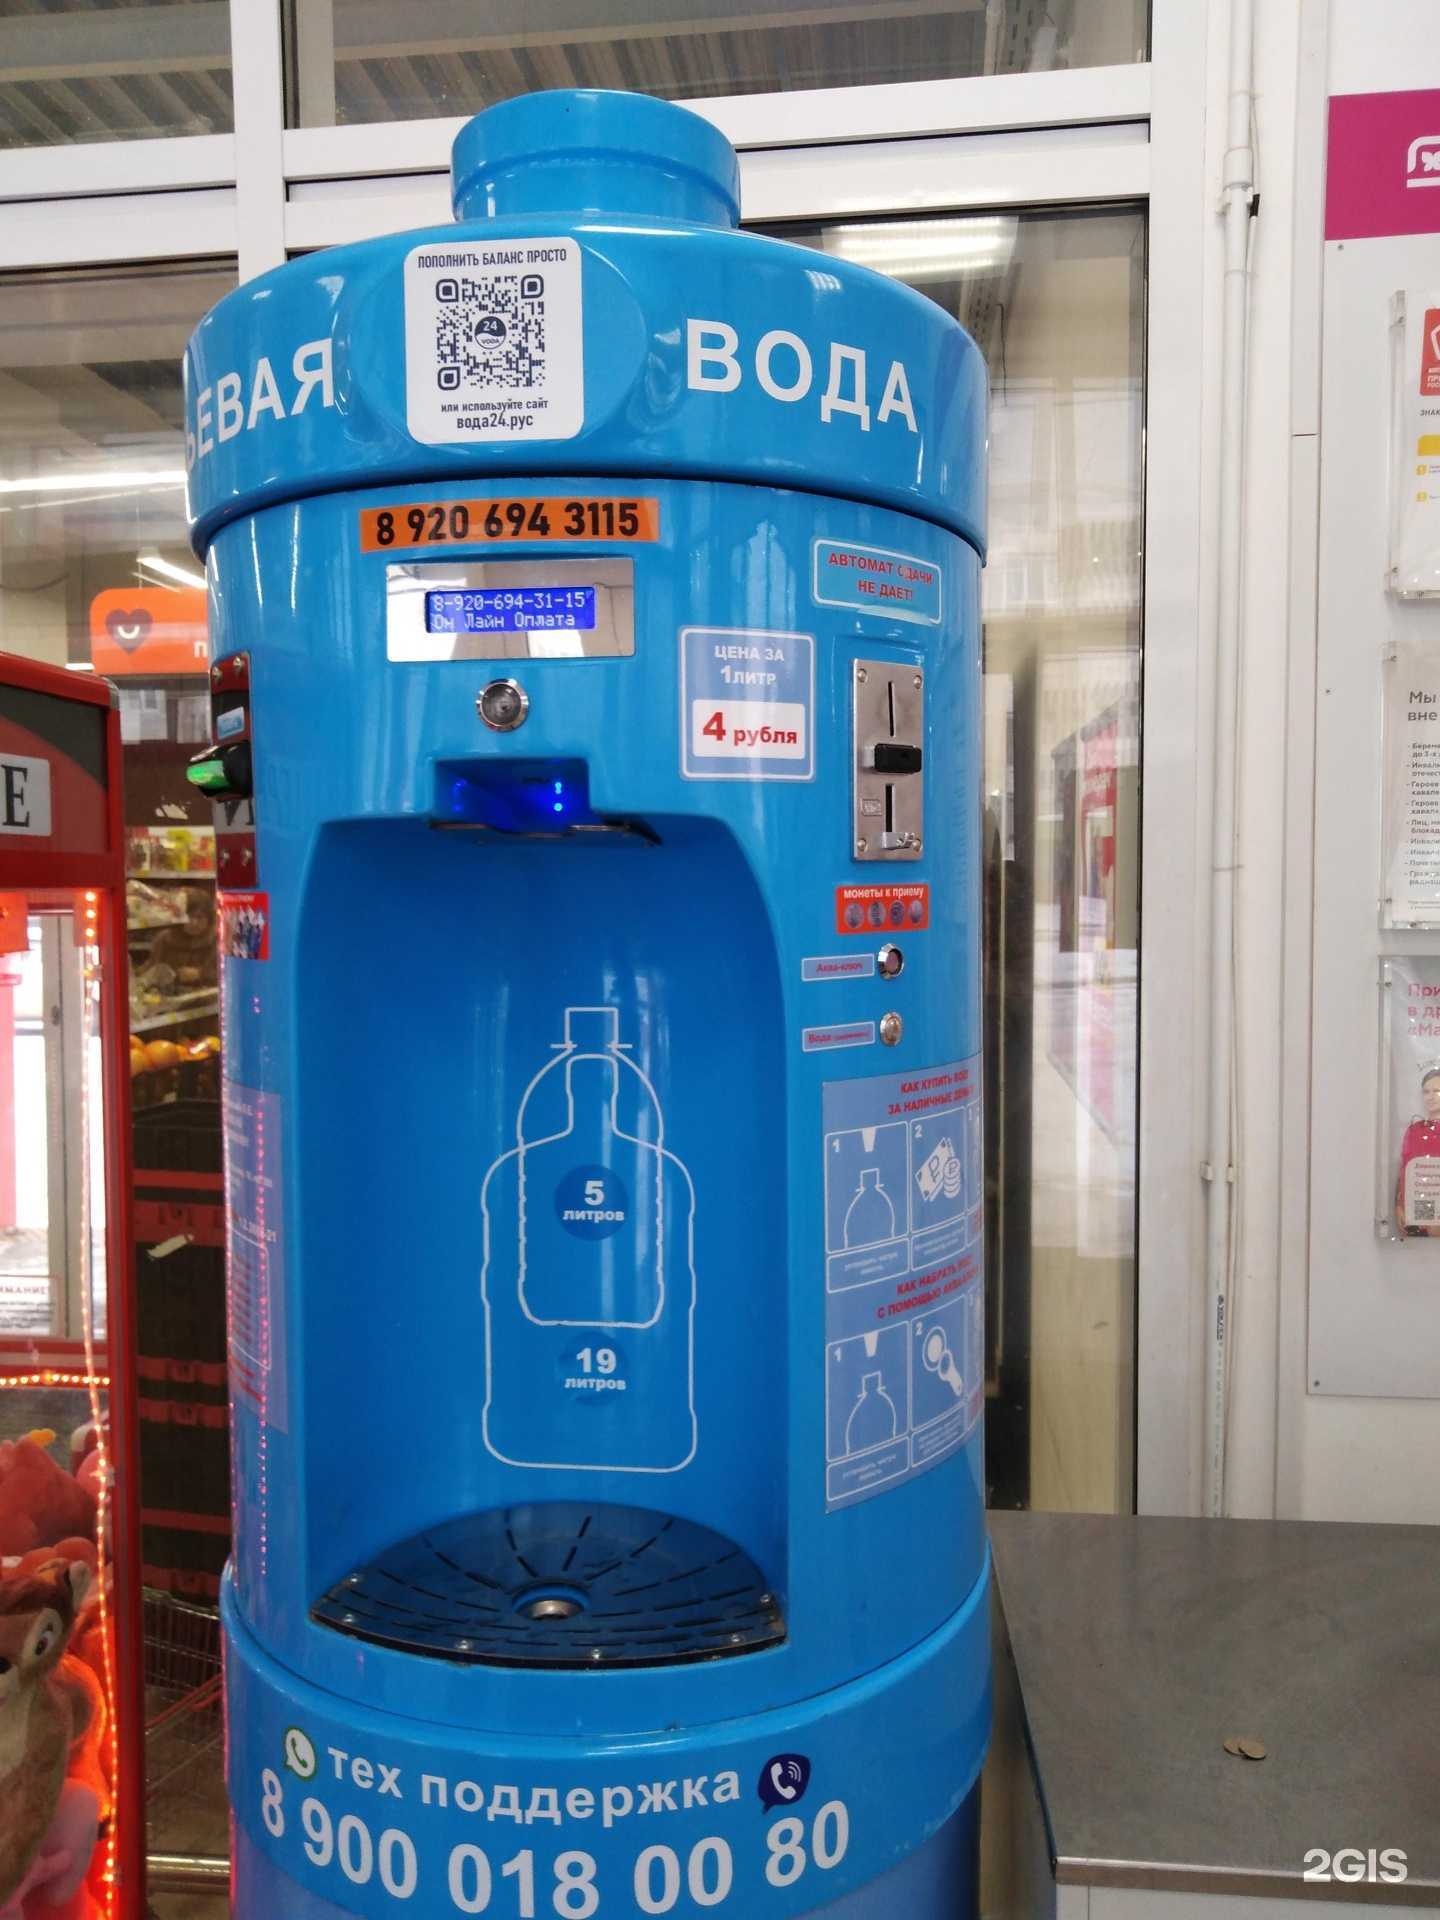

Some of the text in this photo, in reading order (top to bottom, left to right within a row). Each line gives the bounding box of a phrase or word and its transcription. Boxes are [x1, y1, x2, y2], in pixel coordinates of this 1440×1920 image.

[418, 248, 567, 268] ПОПОЛНИТЬ БАЛАНС ПРОСТО
[483, 320, 498, 331] 24
[687, 318, 918, 432] ВОДА
[441, 397, 549, 416] или используйте сайт
[456, 413, 534, 430] вода24.рус
[376, 502, 639, 545] 8 920 694 3115
[828, 552, 893, 575] АВТОМАТ
[857, 580, 876, 593] НЕ
[432, 591, 585, 612] 8-920-694-31-15
[464, 611, 505, 629] Лайн
[514, 611, 576, 628] Оплата
[714, 645, 785, 662] ЦЕНА ЗА
[703, 712, 797, 746] 4 рубля
[843, 887, 924, 899] монеты к приему
[584, 1180, 604, 1206] 5
[562, 1208, 625, 1224] литров
[576, 1348, 617, 1374] 19
[564, 1376, 627, 1392] литров
[327, 1746, 741, 1828] тех поддержка
[261, 1768, 849, 1920] 8 900 018 00 80
